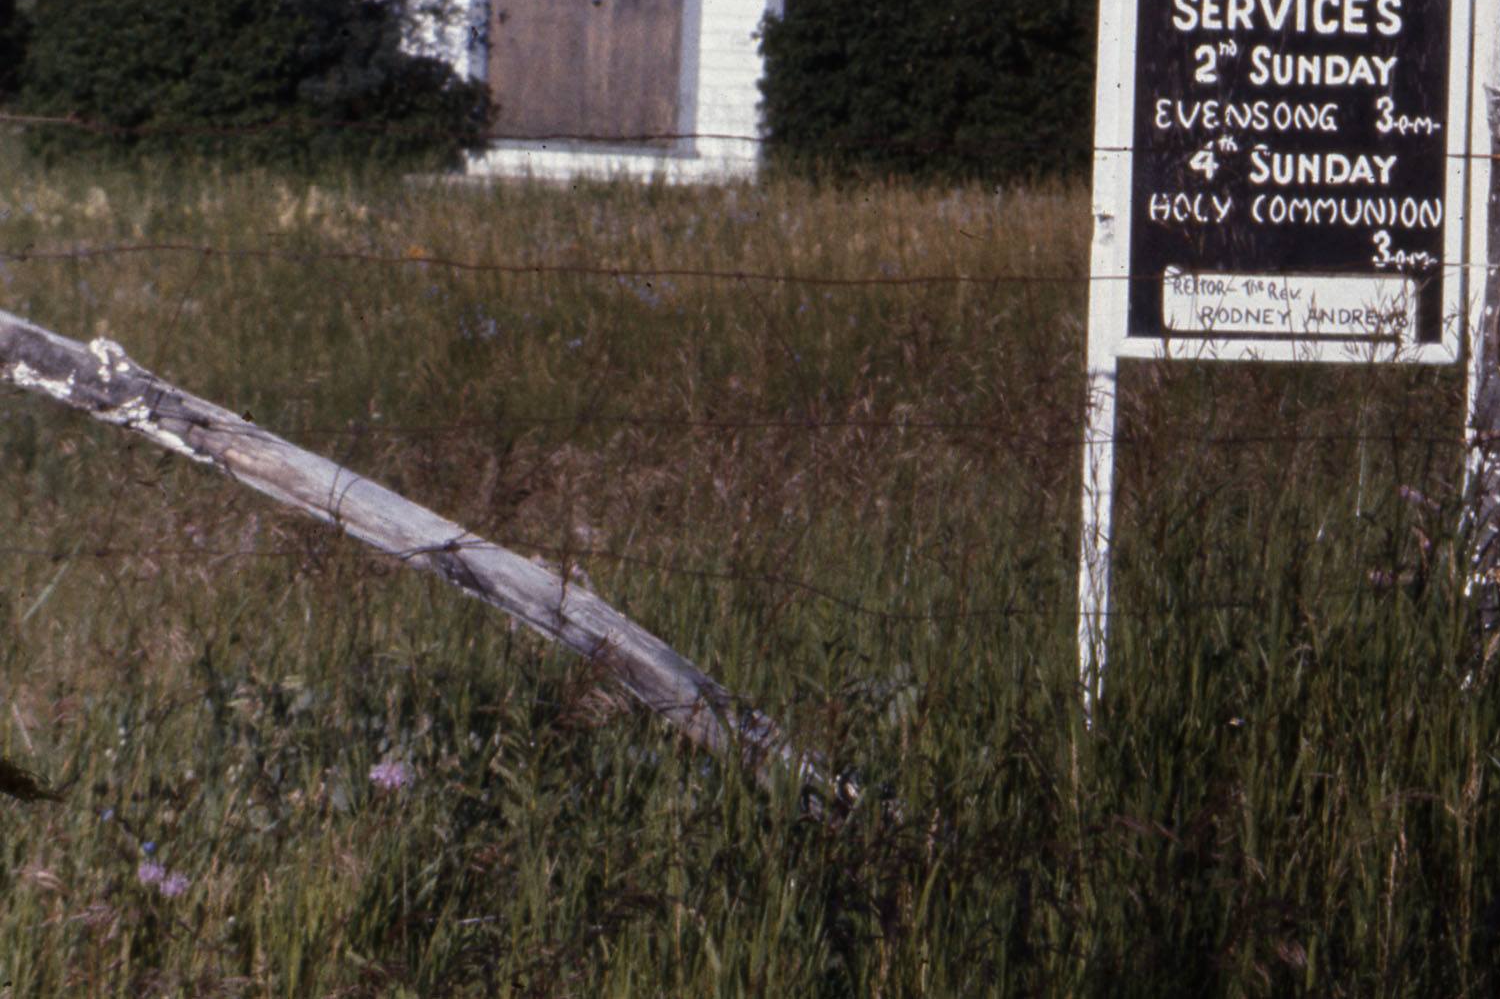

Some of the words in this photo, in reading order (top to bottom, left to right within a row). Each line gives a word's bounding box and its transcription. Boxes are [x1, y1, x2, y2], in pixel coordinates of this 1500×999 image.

[1194, 39, 1238, 84] 2nd
[1249, 45, 1398, 87] SUNDAY
[1155, 98, 1338, 131] EVENSONG
[1189, 136, 1239, 182] 4th
[1249, 144, 1398, 186] SUNDAY
[1149, 192, 1232, 224] HOLY
[1251, 195, 1443, 229] COMMUNION
[1200, 306, 1291, 325] RODNEY
